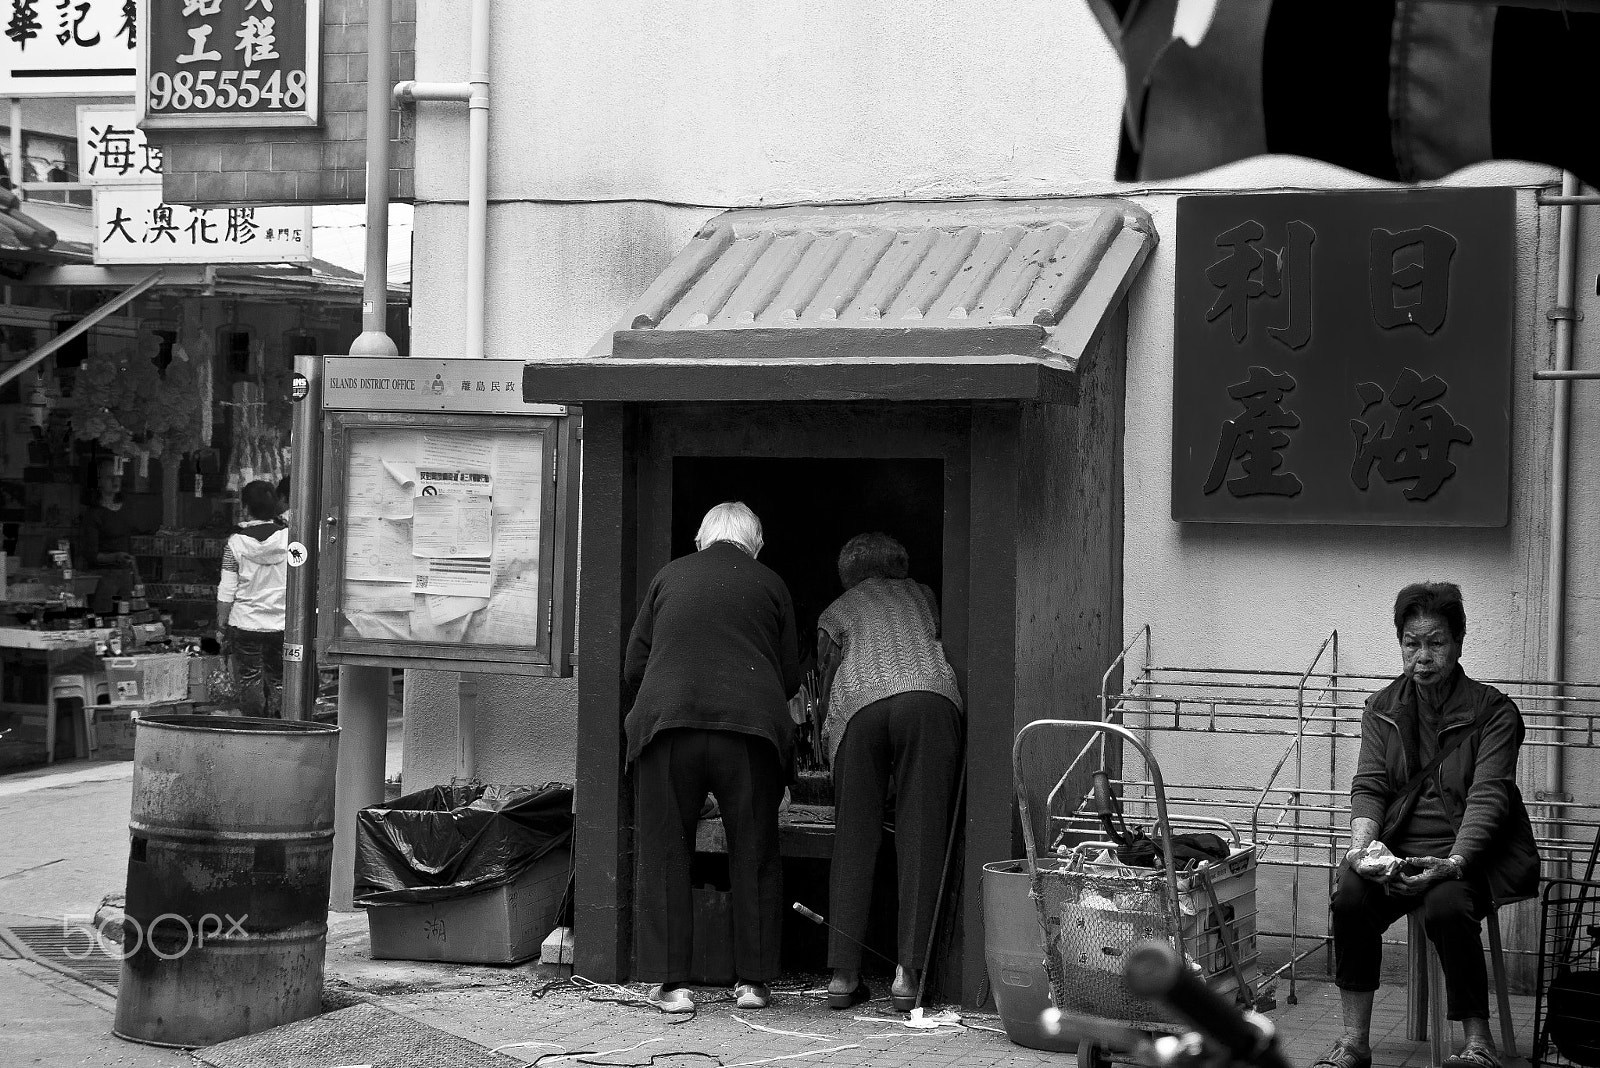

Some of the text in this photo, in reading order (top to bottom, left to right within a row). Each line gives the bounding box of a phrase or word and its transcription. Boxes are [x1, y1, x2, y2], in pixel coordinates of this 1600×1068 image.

[150, 69, 306, 110] 9855548
[103, 203, 260, 245] 大澳花膠
[330, 377, 416, 391] ISLANDS DISTRICT OFFICE
[461, 380, 516, 392] 離島民政
